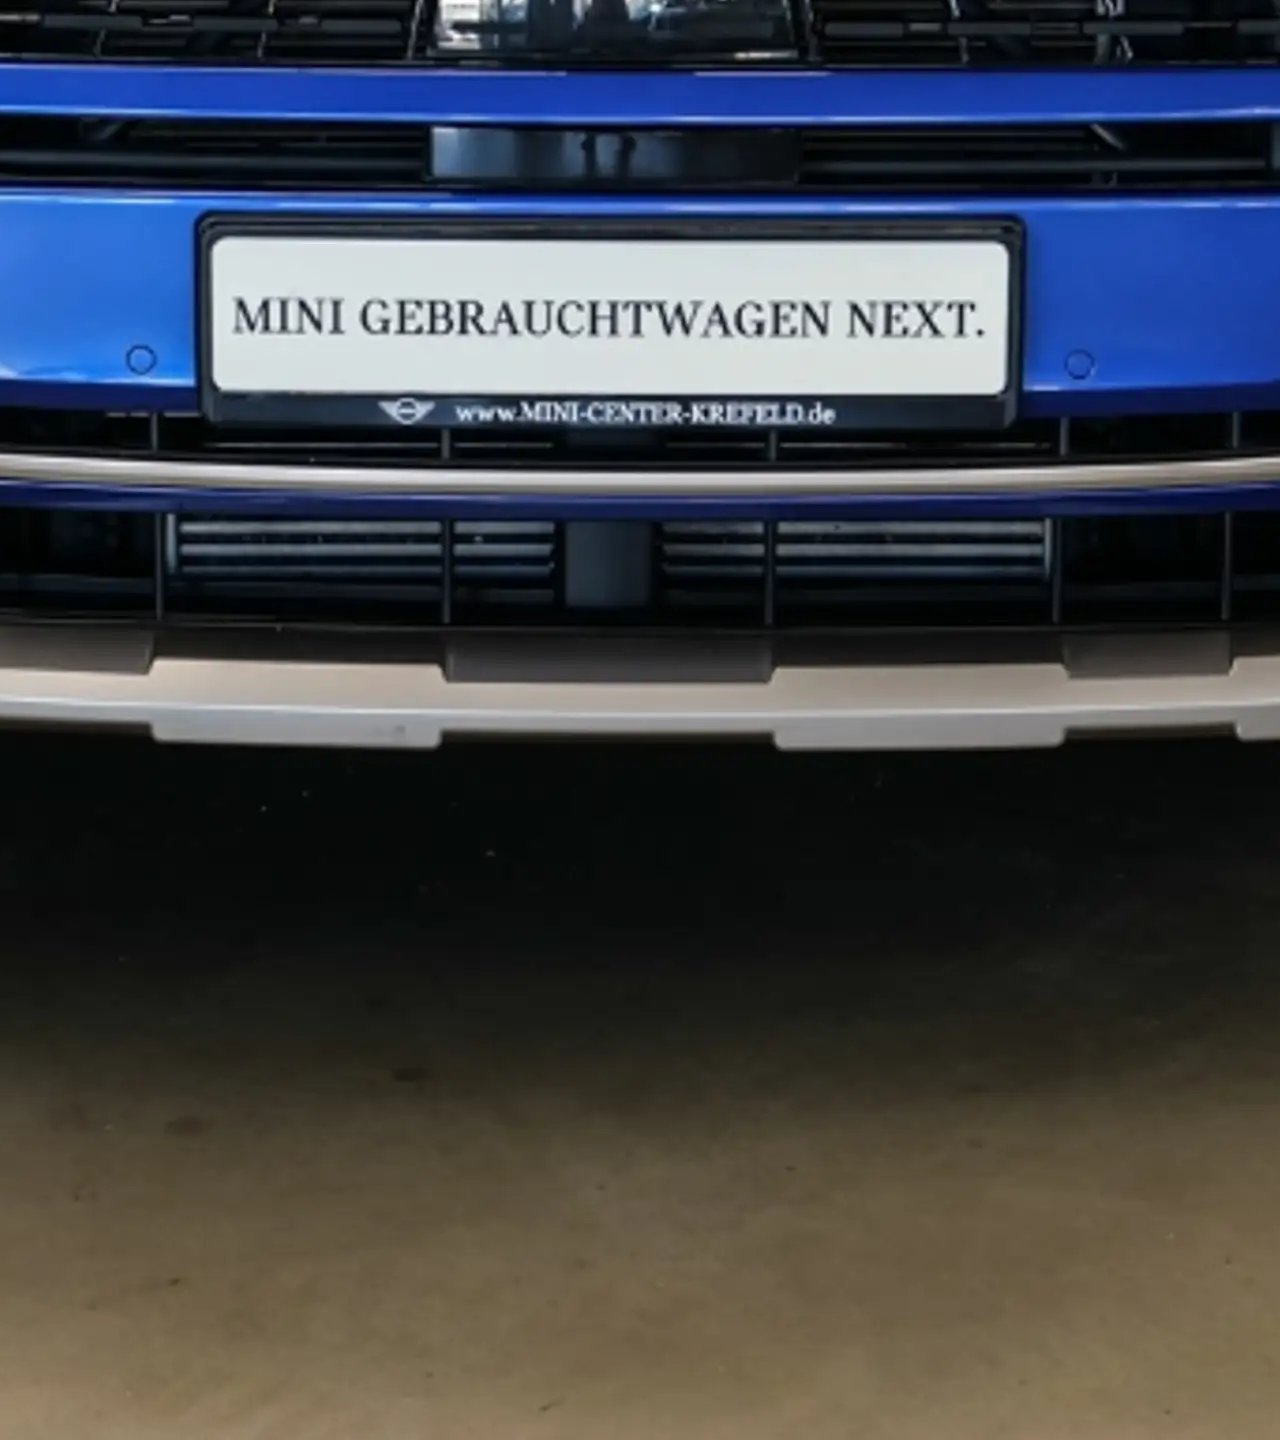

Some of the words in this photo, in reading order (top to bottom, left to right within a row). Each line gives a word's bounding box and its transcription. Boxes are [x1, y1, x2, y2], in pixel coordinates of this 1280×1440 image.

[231, 297, 347, 335] MINI
[358, 298, 832, 339] GEBRAUCHTWAGEN
[846, 299, 987, 340] NEXT.
[454, 400, 838, 426] www.MINI-CENTER-KREFELD.de
